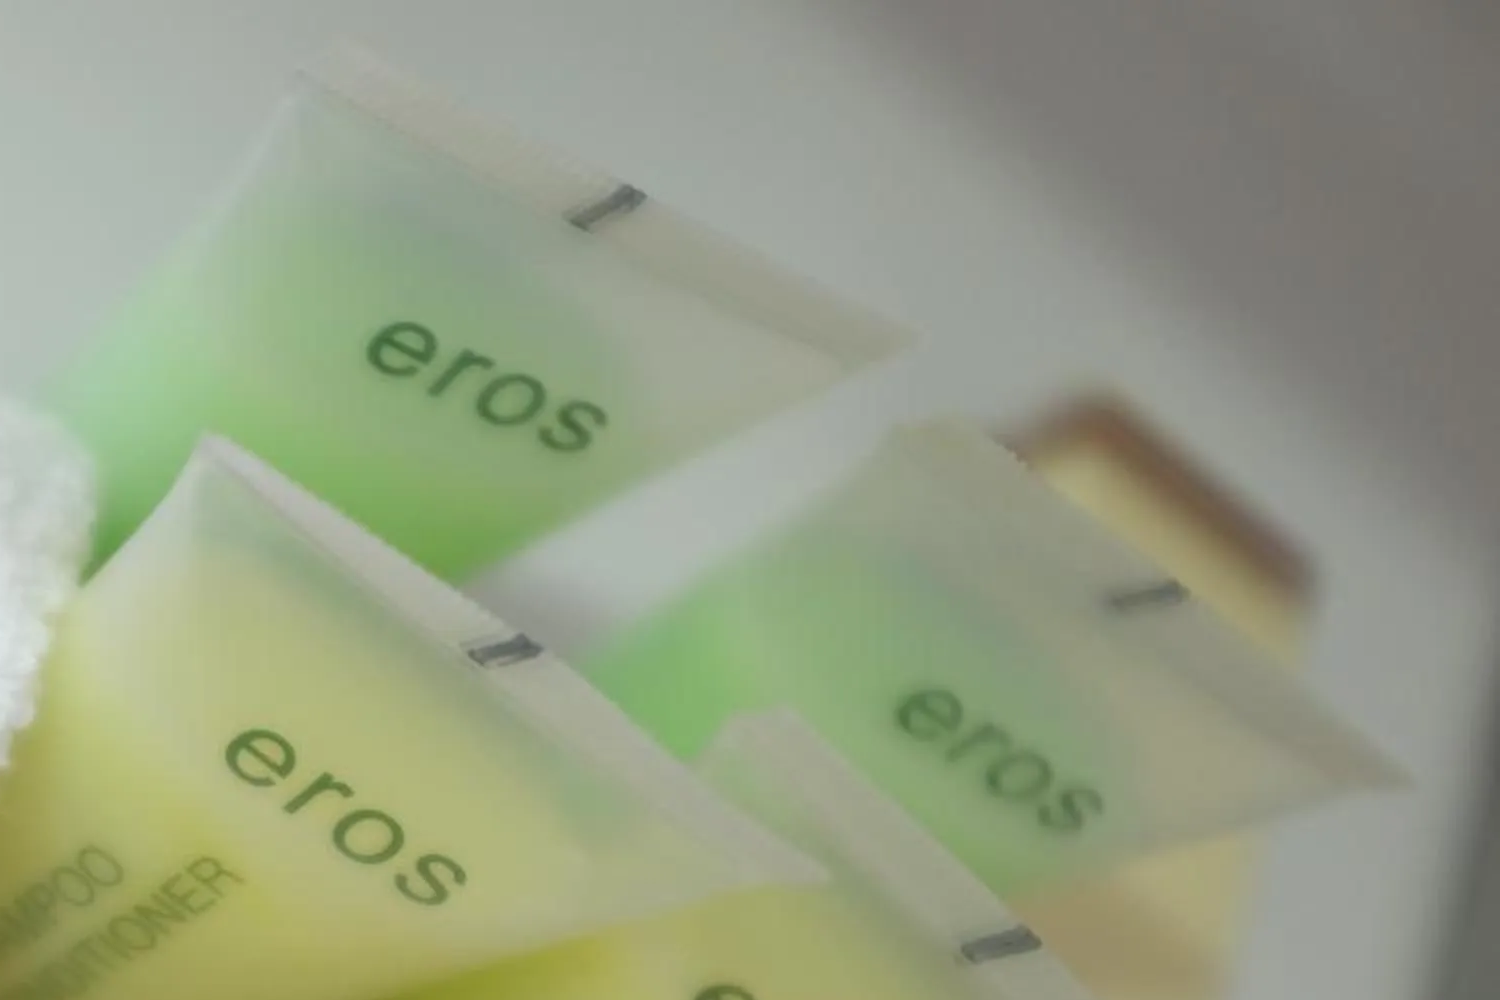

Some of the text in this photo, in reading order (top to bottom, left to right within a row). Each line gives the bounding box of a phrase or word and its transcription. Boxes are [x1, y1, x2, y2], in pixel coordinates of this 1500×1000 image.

[366, 320, 609, 453] eros
[224, 727, 468, 906] eros
[894, 688, 1105, 832] eros
